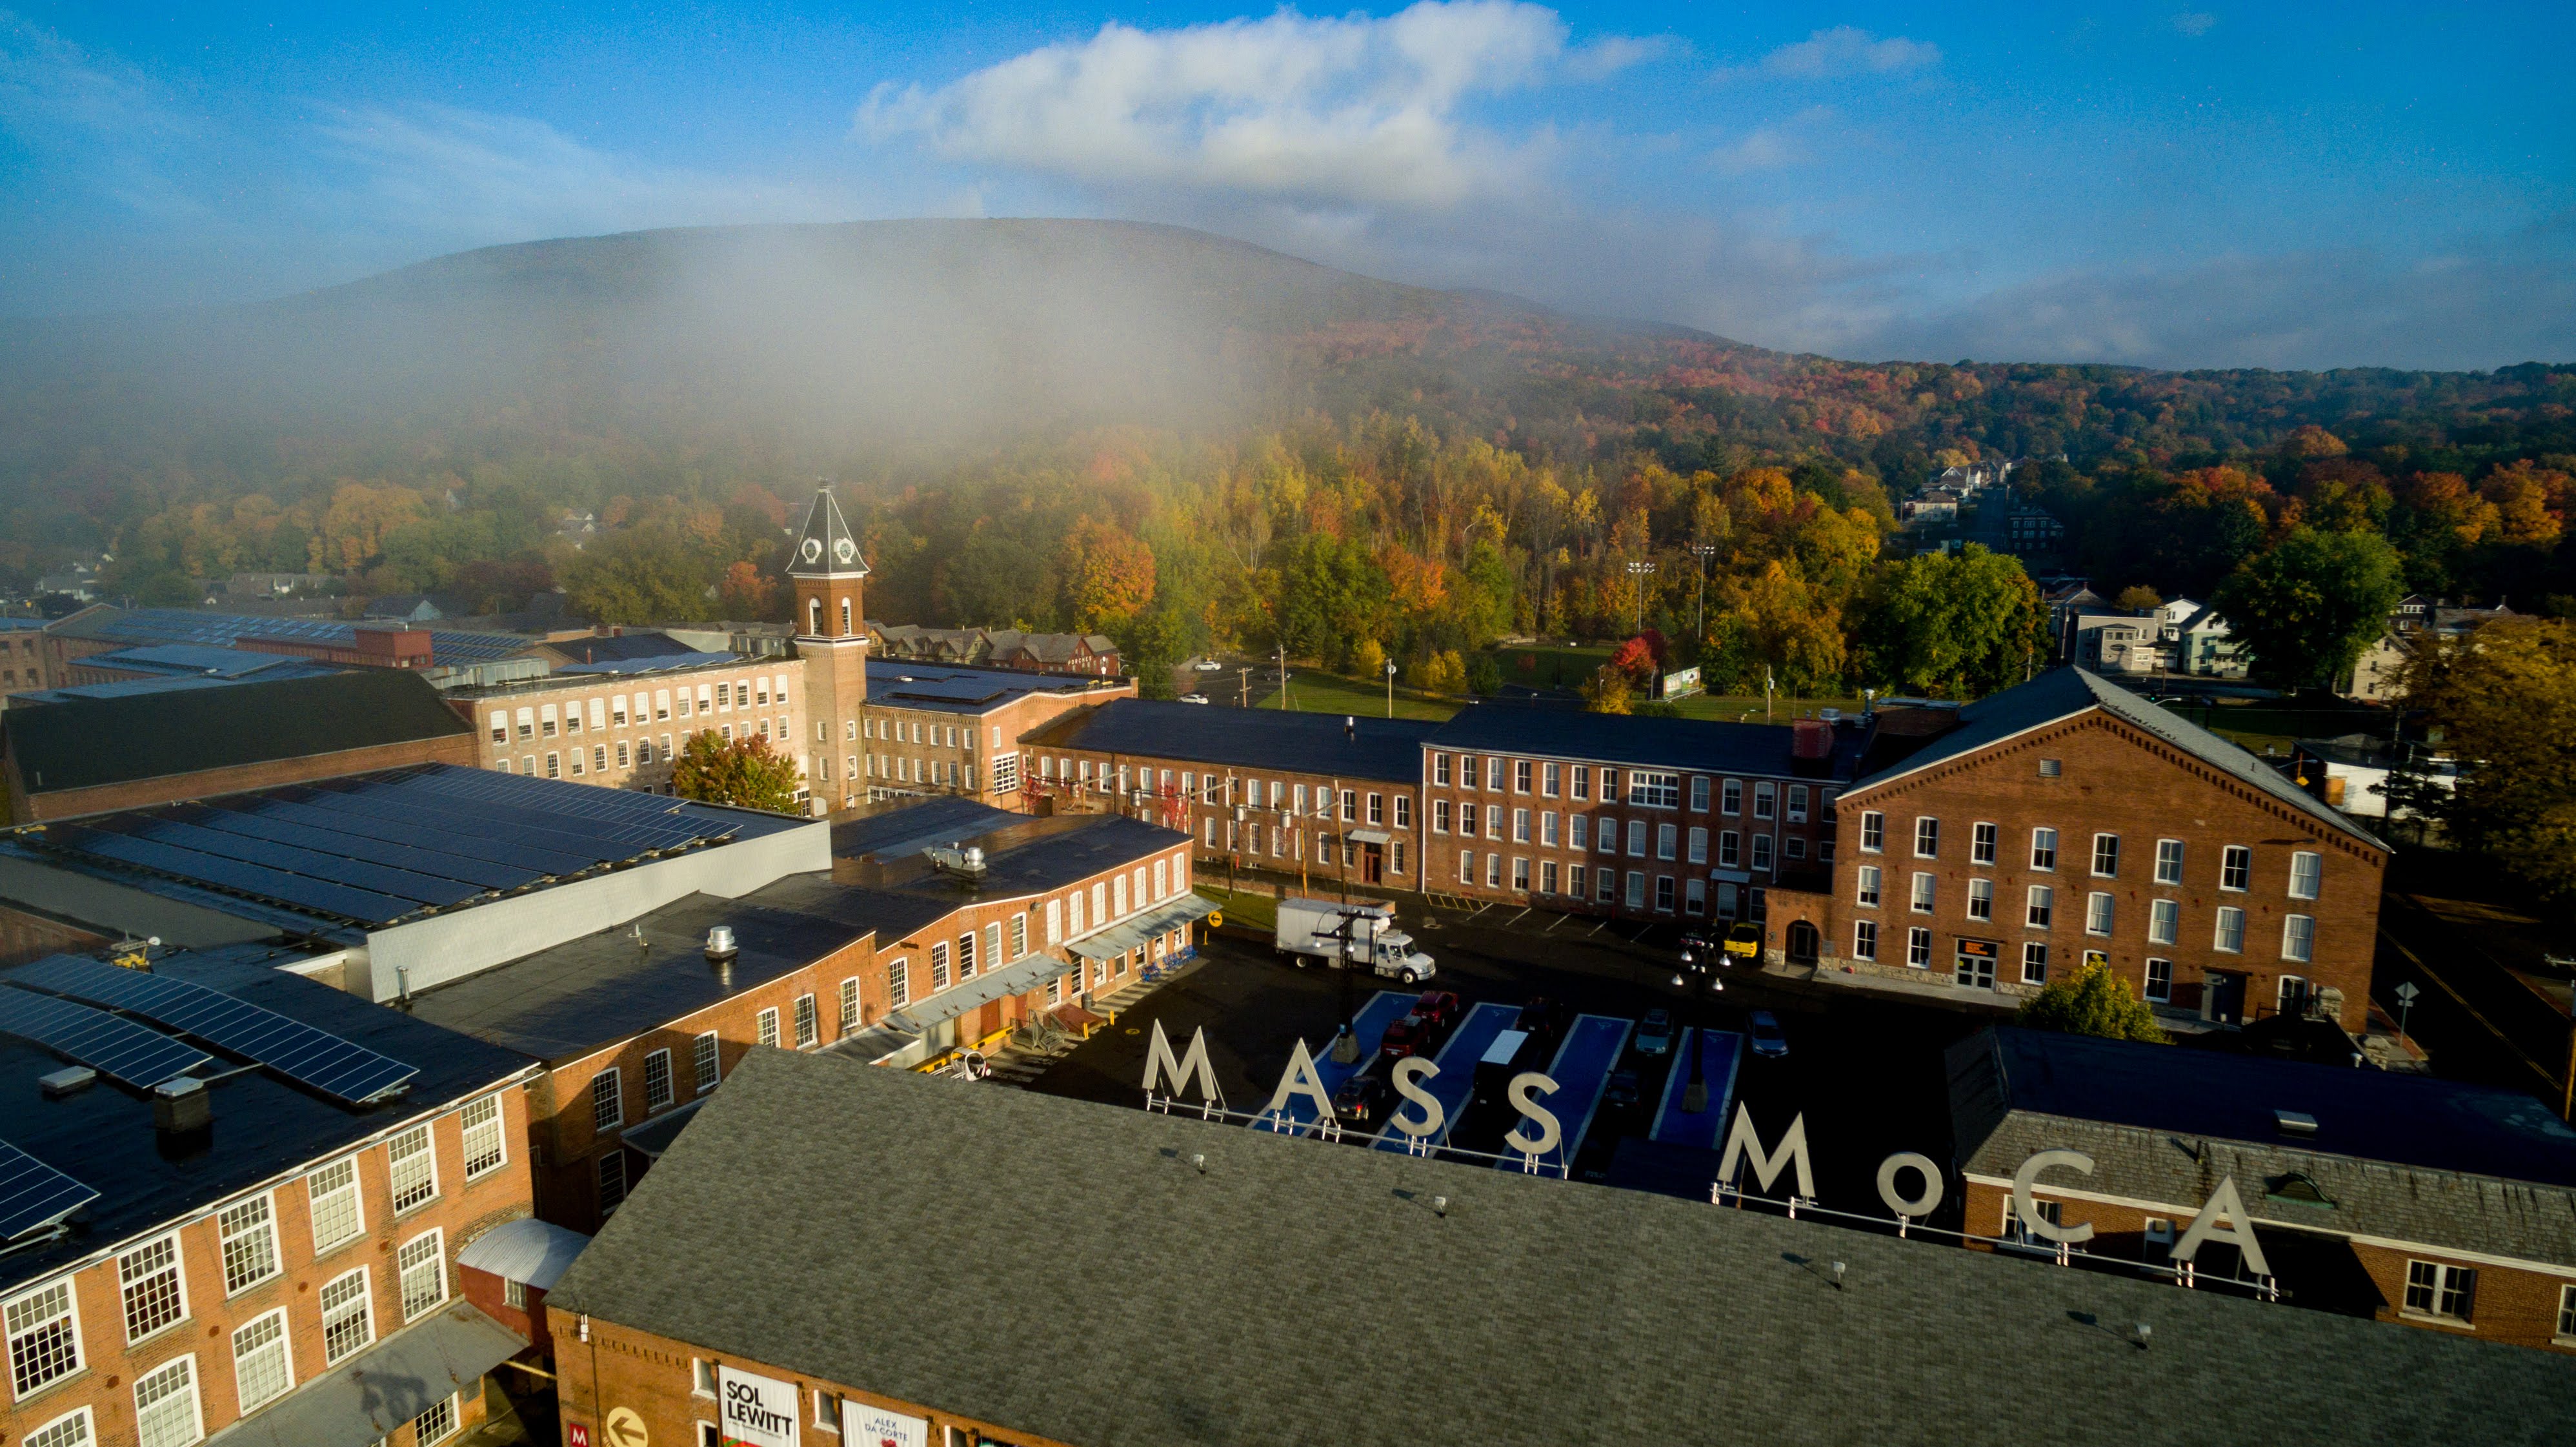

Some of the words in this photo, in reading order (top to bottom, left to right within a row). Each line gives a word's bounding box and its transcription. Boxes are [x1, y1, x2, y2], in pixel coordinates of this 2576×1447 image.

[1142, 1018, 1562, 1154] MASS
[727, 1380, 763, 1408] SOL
[727, 1400, 792, 1436] LEWITT
[875, 1417, 897, 1429] ALEX
[572, 1428, 587, 1446] M
[865, 1423, 876, 1433] DA
[880, 1427, 908, 1441] CORTE
